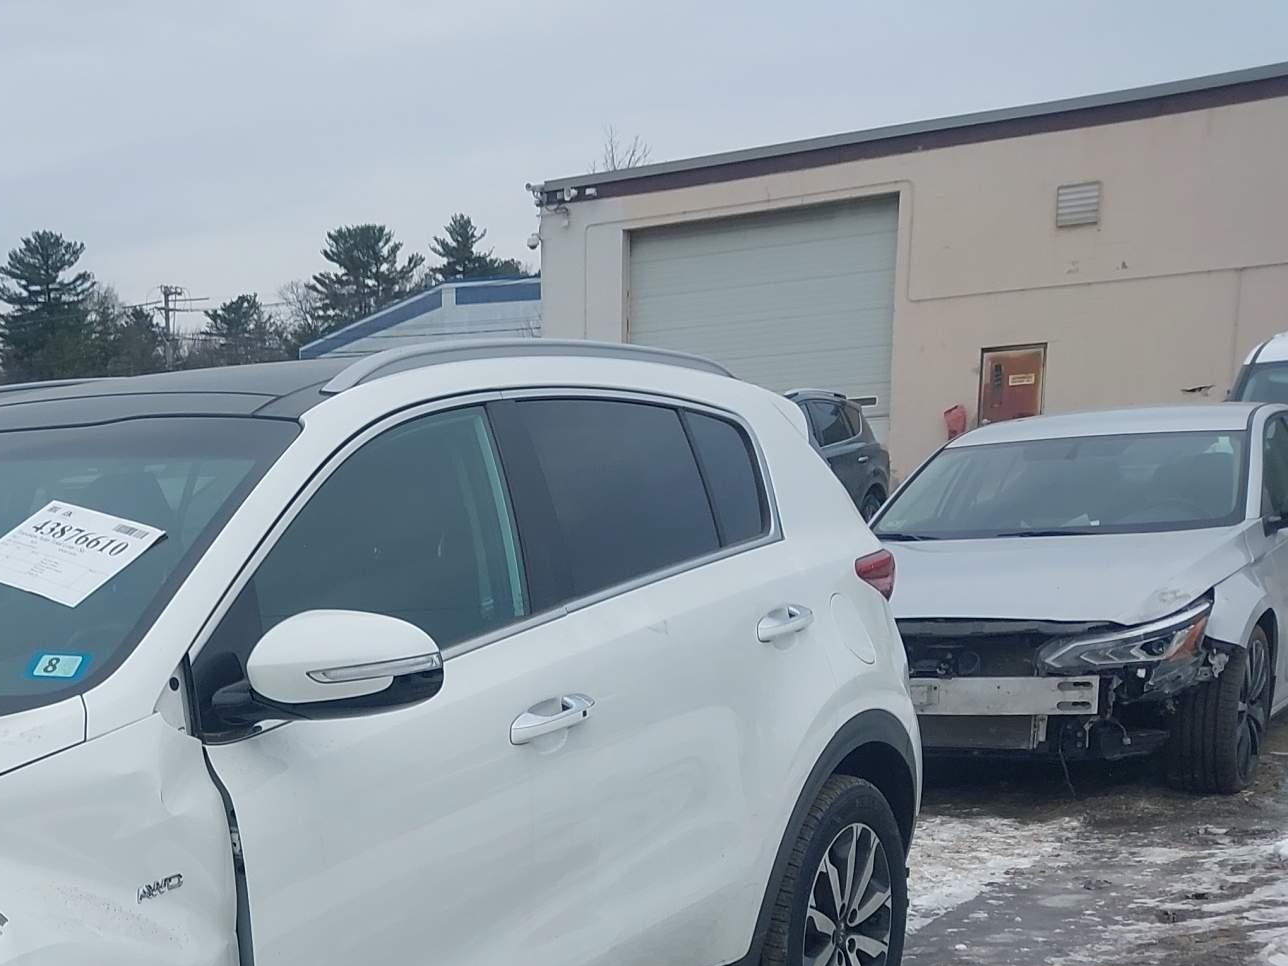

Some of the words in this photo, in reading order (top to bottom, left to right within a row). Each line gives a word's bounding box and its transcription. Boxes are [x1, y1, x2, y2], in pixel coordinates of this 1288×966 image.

[32, 519, 130, 557] 43876610
[43, 656, 61, 674] 8
[136, 872, 184, 905] AWD
